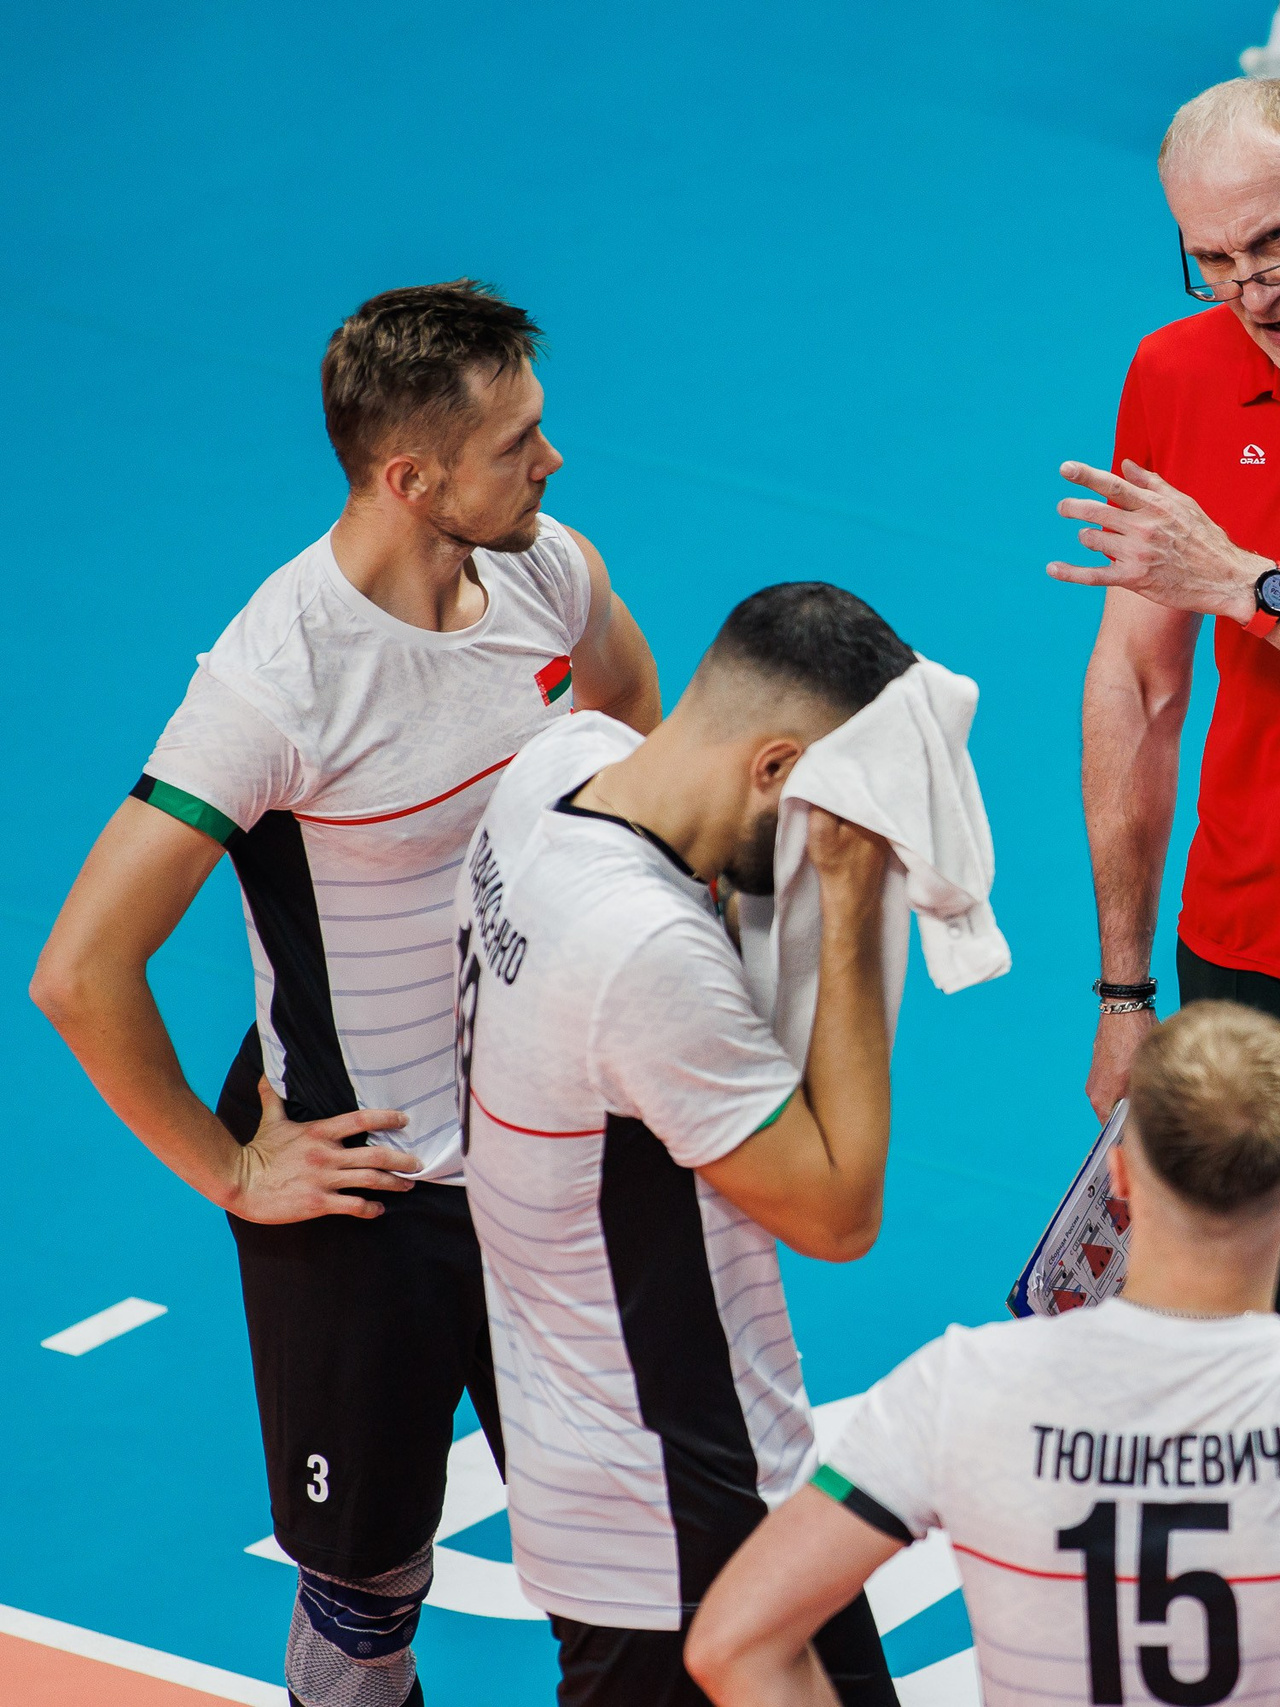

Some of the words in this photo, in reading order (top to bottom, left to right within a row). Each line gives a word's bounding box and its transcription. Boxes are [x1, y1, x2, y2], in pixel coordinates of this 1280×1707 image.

[1048, 1237, 1068, 1266] Сборная
[1065, 1215, 1081, 1238] России
[307, 1454, 329, 1503] 3
[1057, 1501, 1241, 1707] 15
